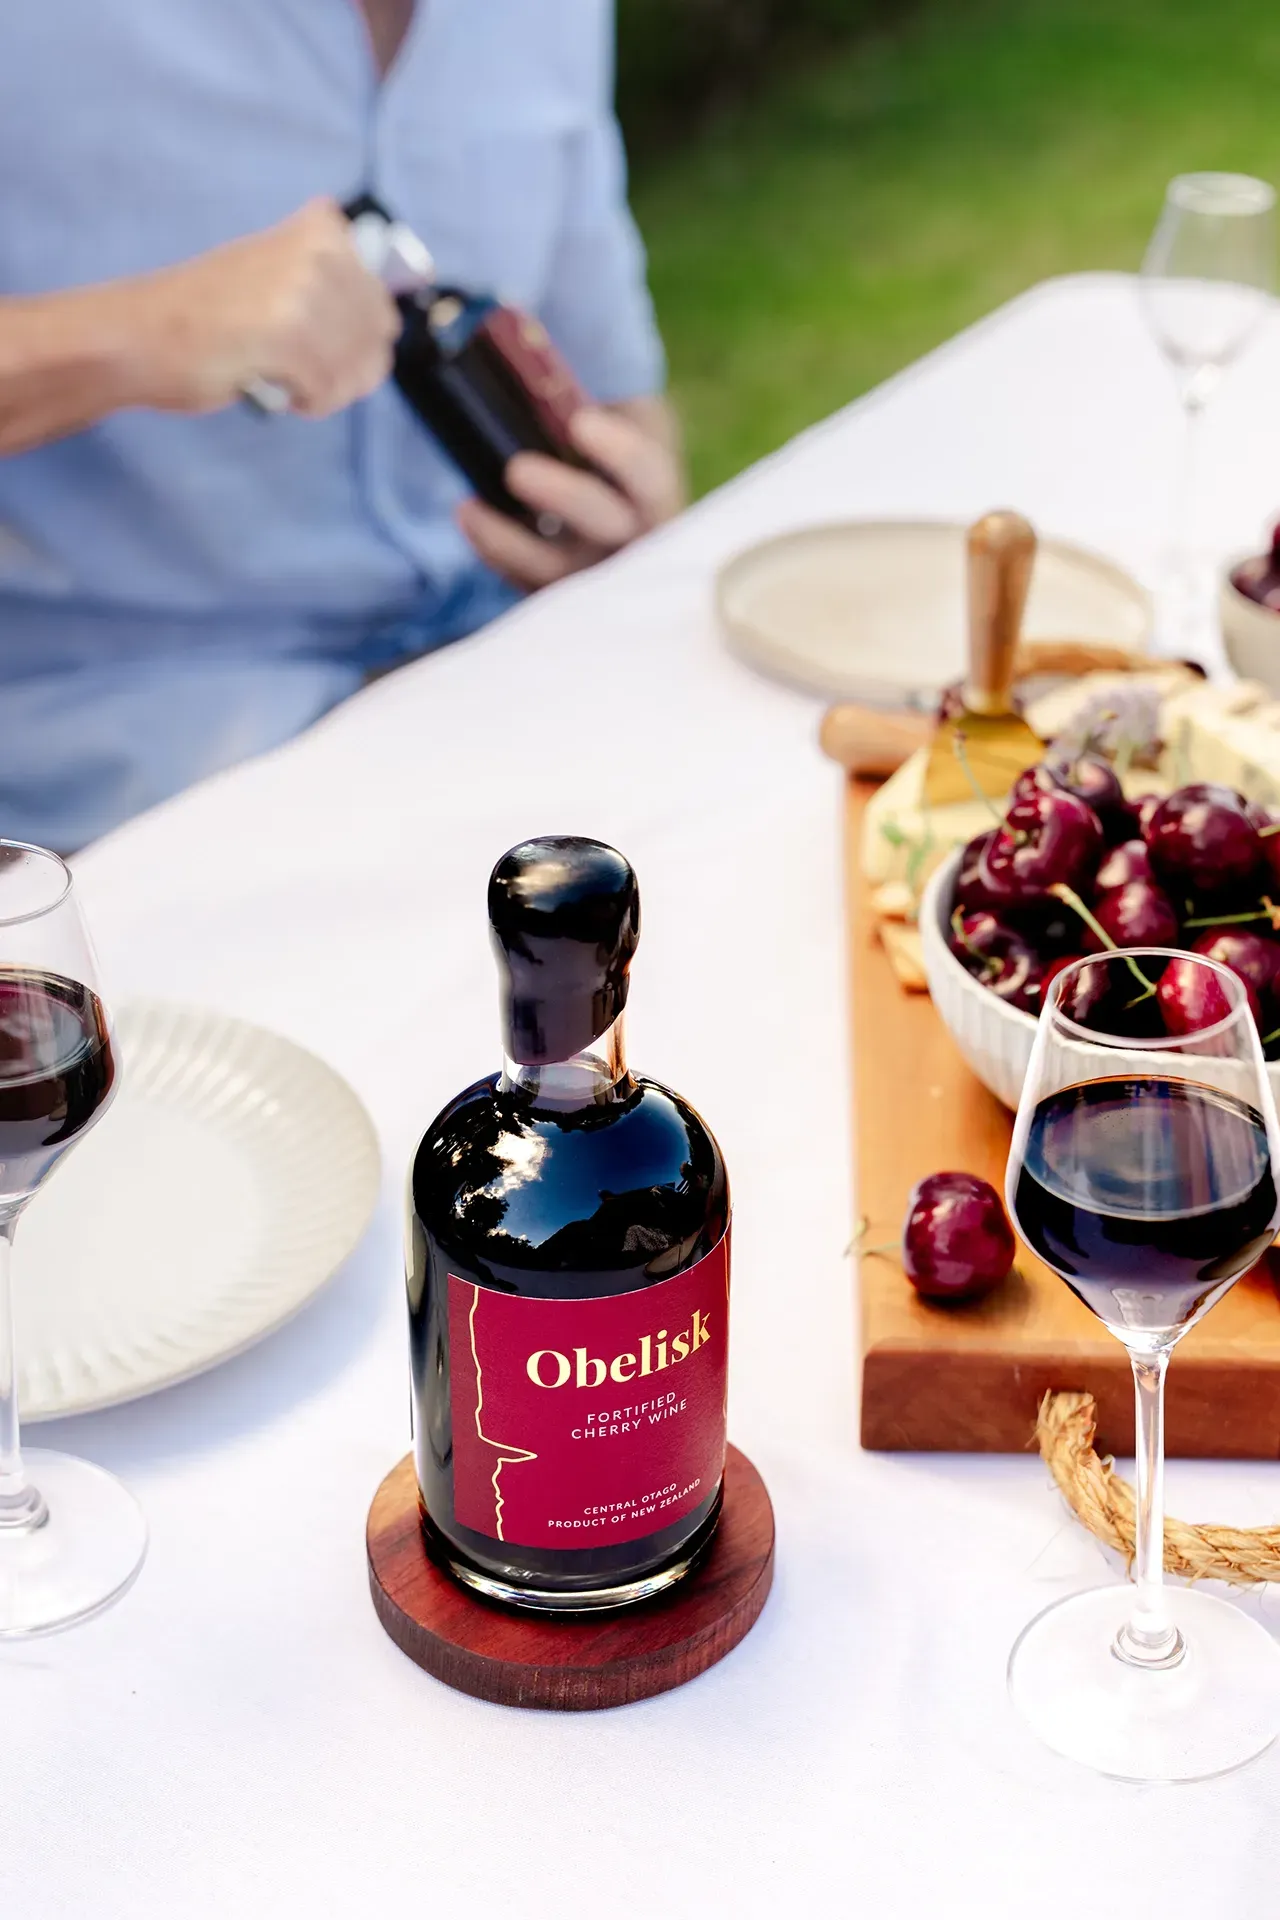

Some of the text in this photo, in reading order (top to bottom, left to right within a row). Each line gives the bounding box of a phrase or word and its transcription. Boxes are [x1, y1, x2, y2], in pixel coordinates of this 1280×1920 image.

[526, 1309, 711, 1389] Obelisk
[571, 1398, 688, 1440] CHERRY WINE
[587, 1391, 677, 1425] FORTIFIED
[548, 1478, 701, 1528] PRODUCT OF NEW ZEALAND
[583, 1483, 677, 1515] CENTRAL OTAGO
